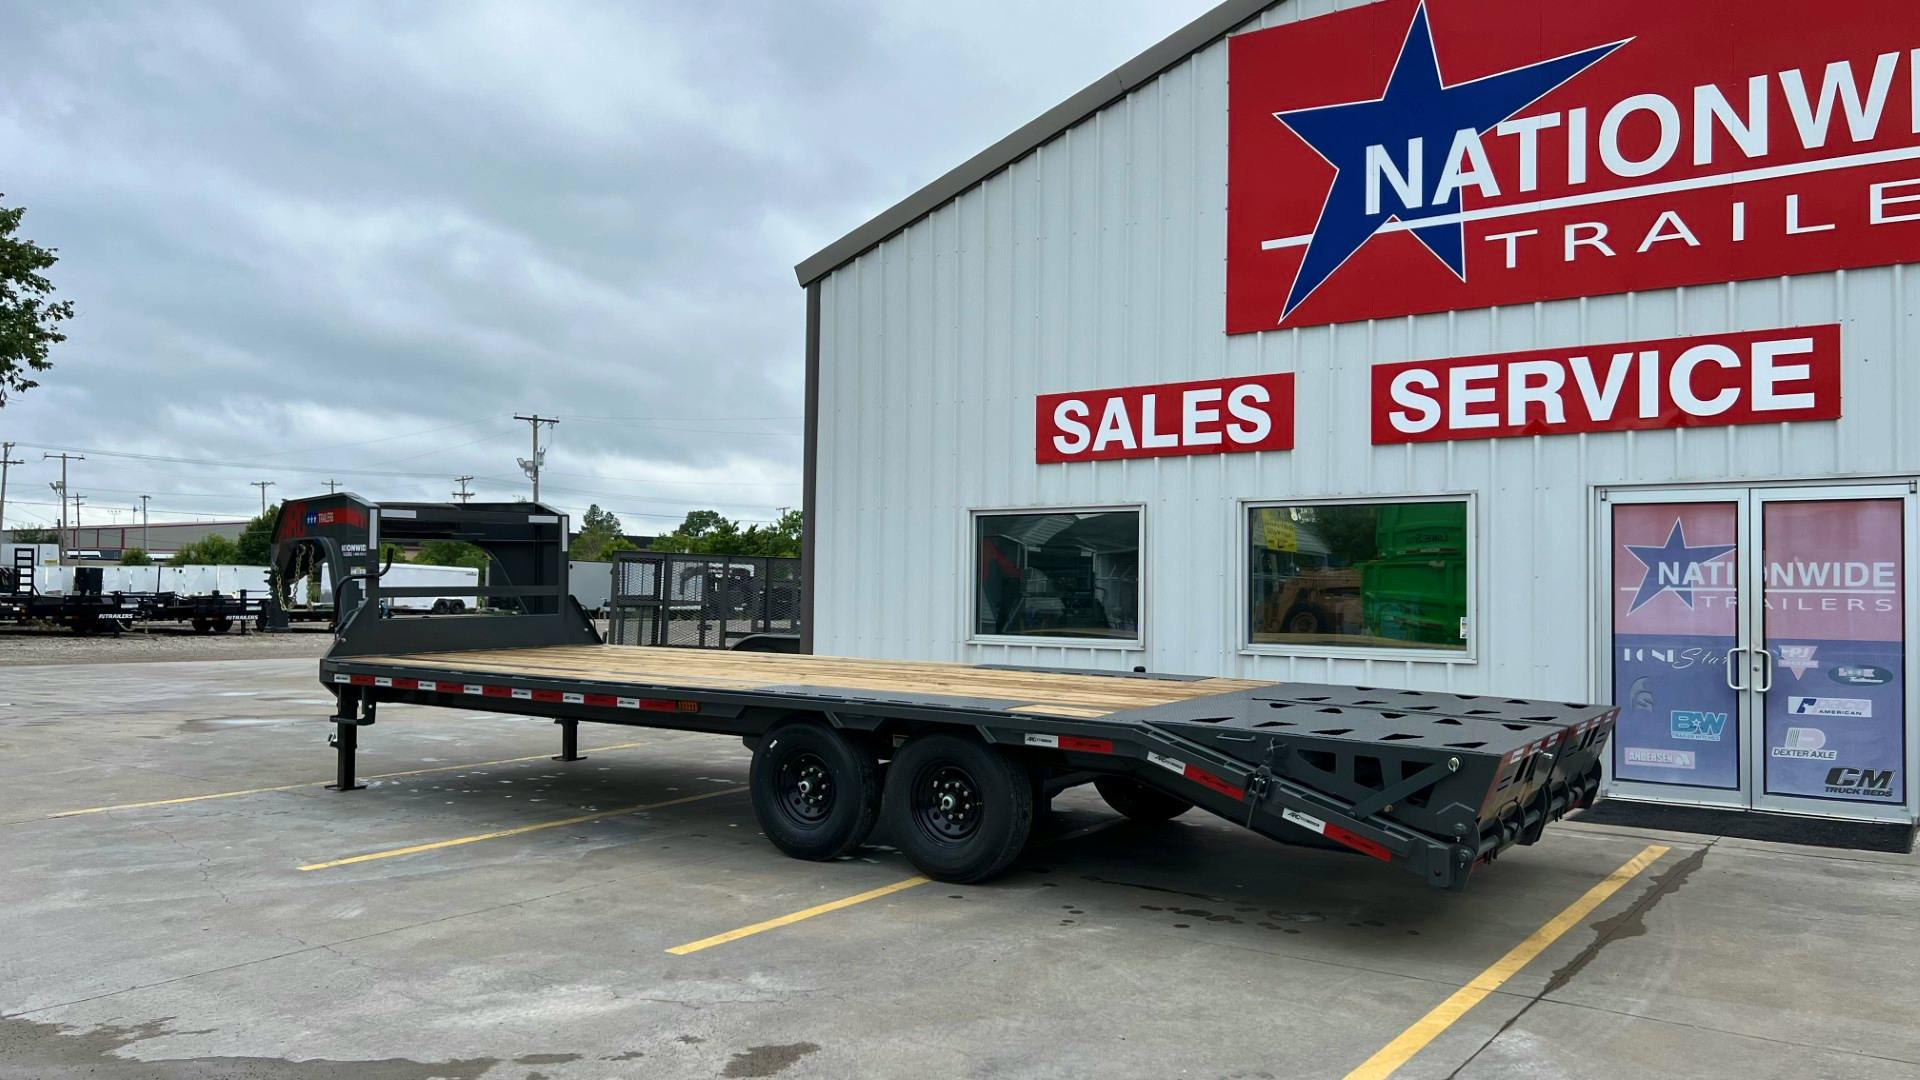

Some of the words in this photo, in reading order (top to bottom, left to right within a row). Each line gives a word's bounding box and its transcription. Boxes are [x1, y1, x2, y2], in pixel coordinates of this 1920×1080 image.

[1388, 337, 1815, 434] SERVICE
[1052, 383, 1272, 455] SALES
[1658, 561, 1896, 588] NATINWIDE
[1628, 751, 1673, 763] ANDERSEN
[1773, 748, 1809, 758] DEXTER
[1810, 750, 1836, 759] AXLE
[1825, 767, 1895, 789] CM
[1825, 786, 1861, 795] TRUCK
[1861, 788, 1893, 797] BEDS
